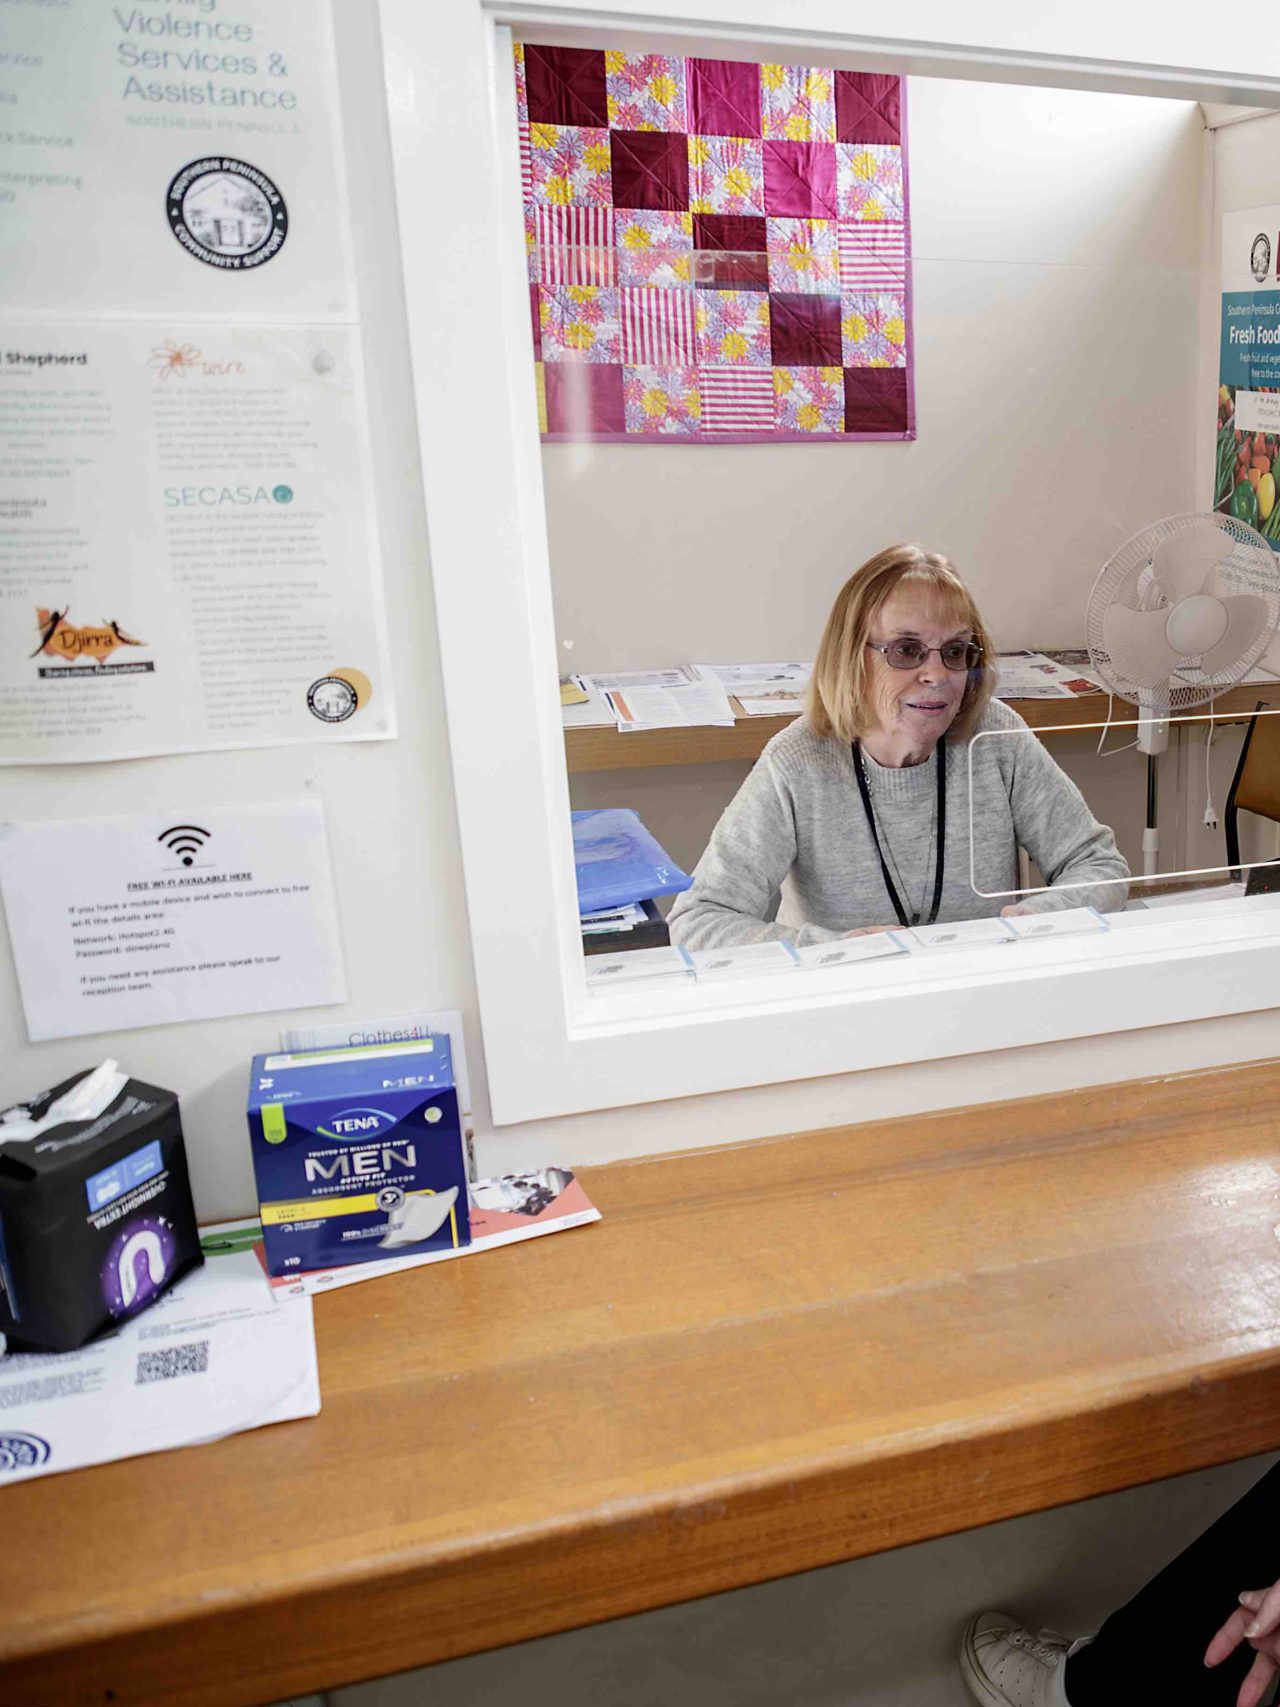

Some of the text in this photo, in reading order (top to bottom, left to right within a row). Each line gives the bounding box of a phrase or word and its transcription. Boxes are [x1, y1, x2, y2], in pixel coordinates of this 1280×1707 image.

[113, 8, 253, 42] Violence
[117, 43, 288, 77] Services &
[122, 76, 298, 110] Assistance
[171, 159, 280, 206] SOUTHERN PENINSULA
[174, 224, 285, 268] COMMUNITY SUPPORT
[1228, 305, 1251, 316] Southern
[1252, 304, 1274, 315] Peninsula
[1230, 325, 1255, 344] Fresh
[1257, 325, 1280, 344] Food
[6, 353, 87, 367] Shepherd
[164, 486, 272, 507] SECASA
[59, 630, 113, 654] Djirra
[127, 881, 149, 891] FREE
[178, 875, 227, 887] AVAILABLE
[229, 873, 252, 882] HERE
[382, 1074, 434, 1088] MEN
[332, 1116, 379, 1133] TENA
[305, 1145, 417, 1182] MEN
[365, 1175, 415, 1187] PROTECTOR
